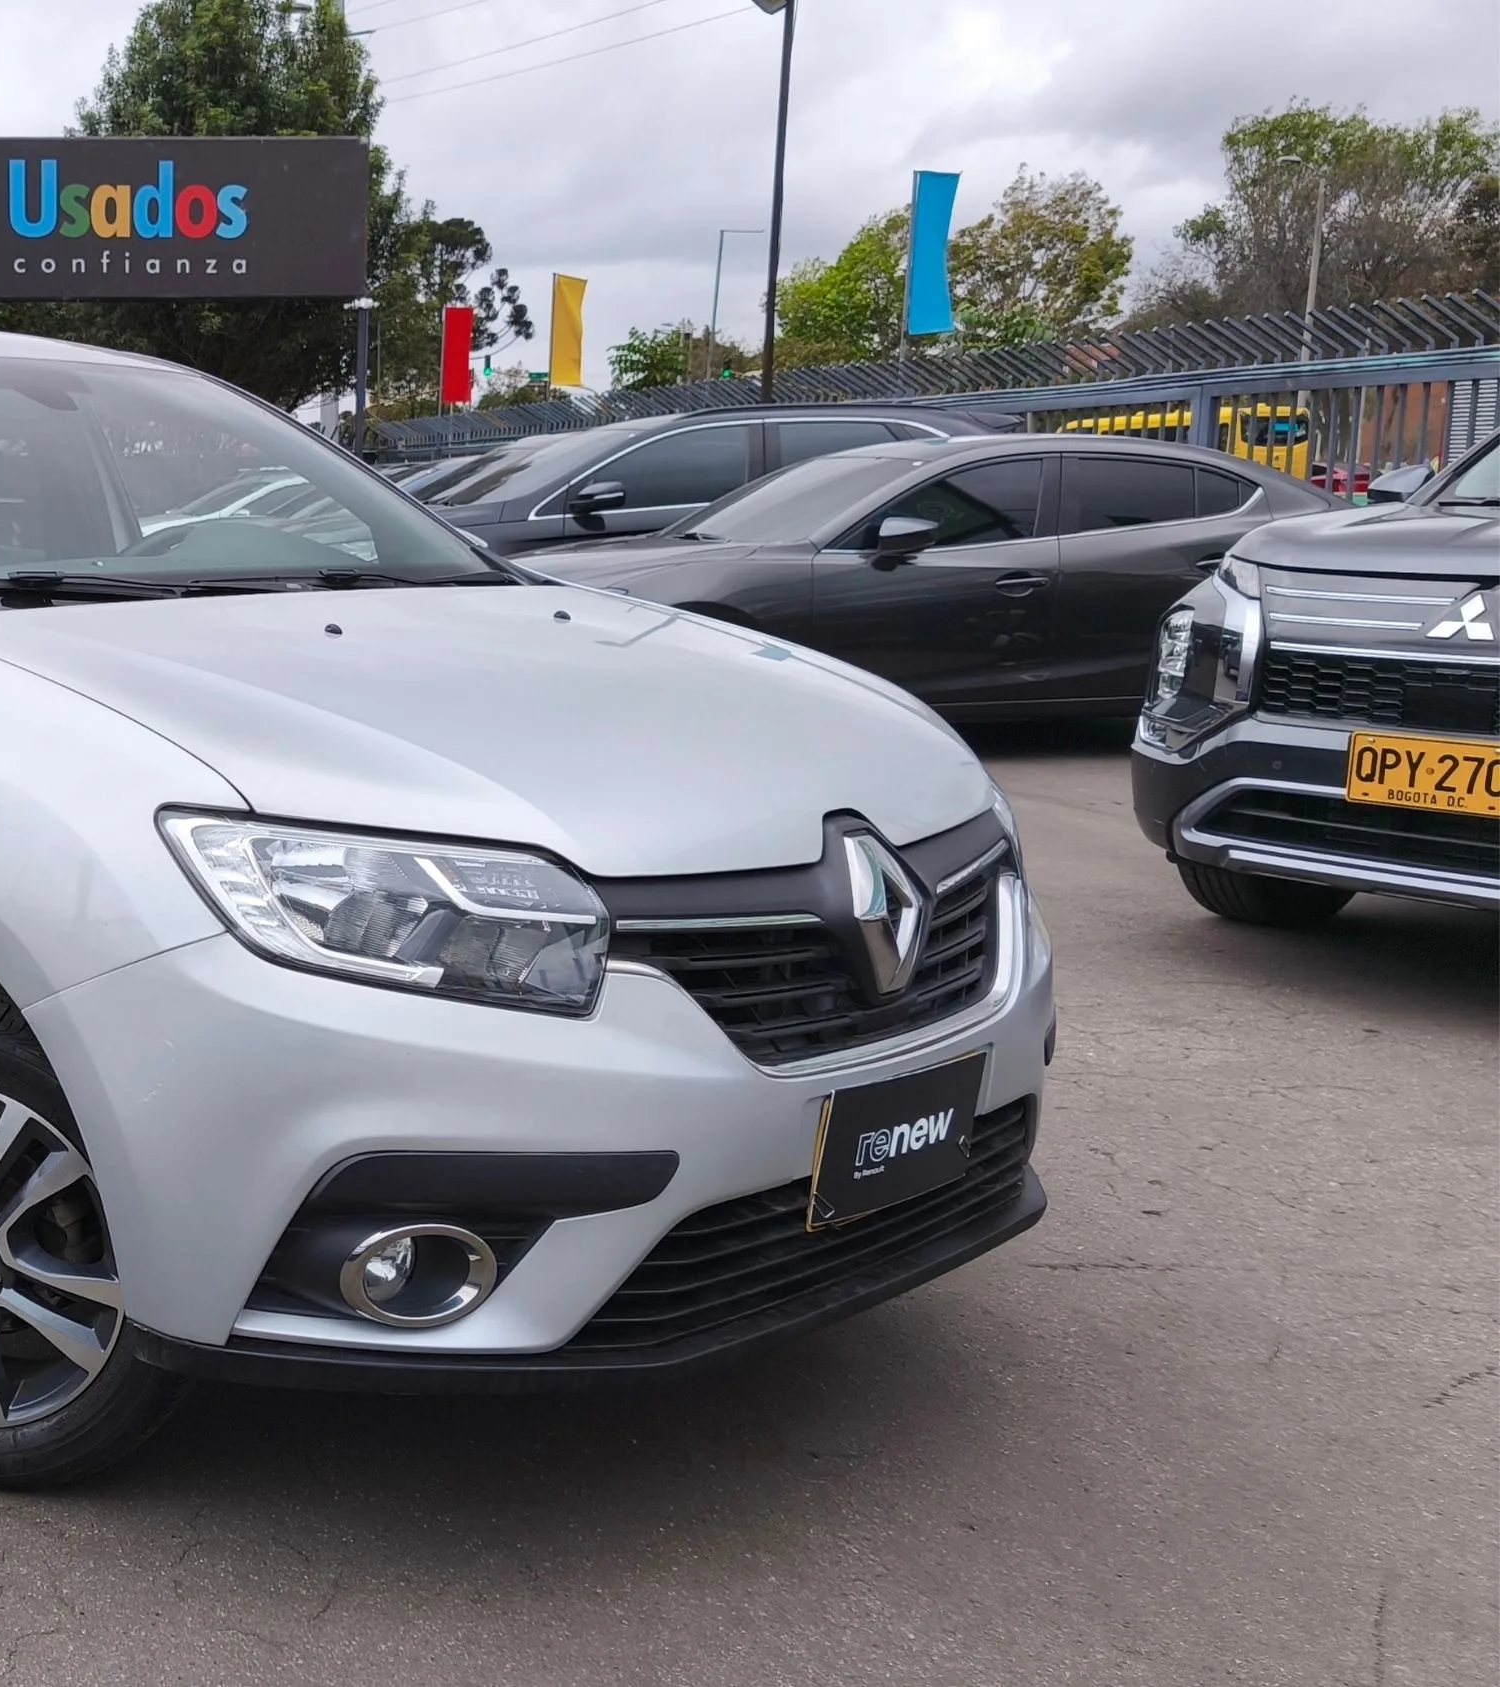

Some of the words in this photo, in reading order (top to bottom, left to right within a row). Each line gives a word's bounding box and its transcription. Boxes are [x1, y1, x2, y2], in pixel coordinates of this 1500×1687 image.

[8, 159, 249, 239] Usados
[13, 250, 247, 274] confianza
[1387, 788, 1437, 805] BOGOTA
[855, 1107, 954, 1167] renew
